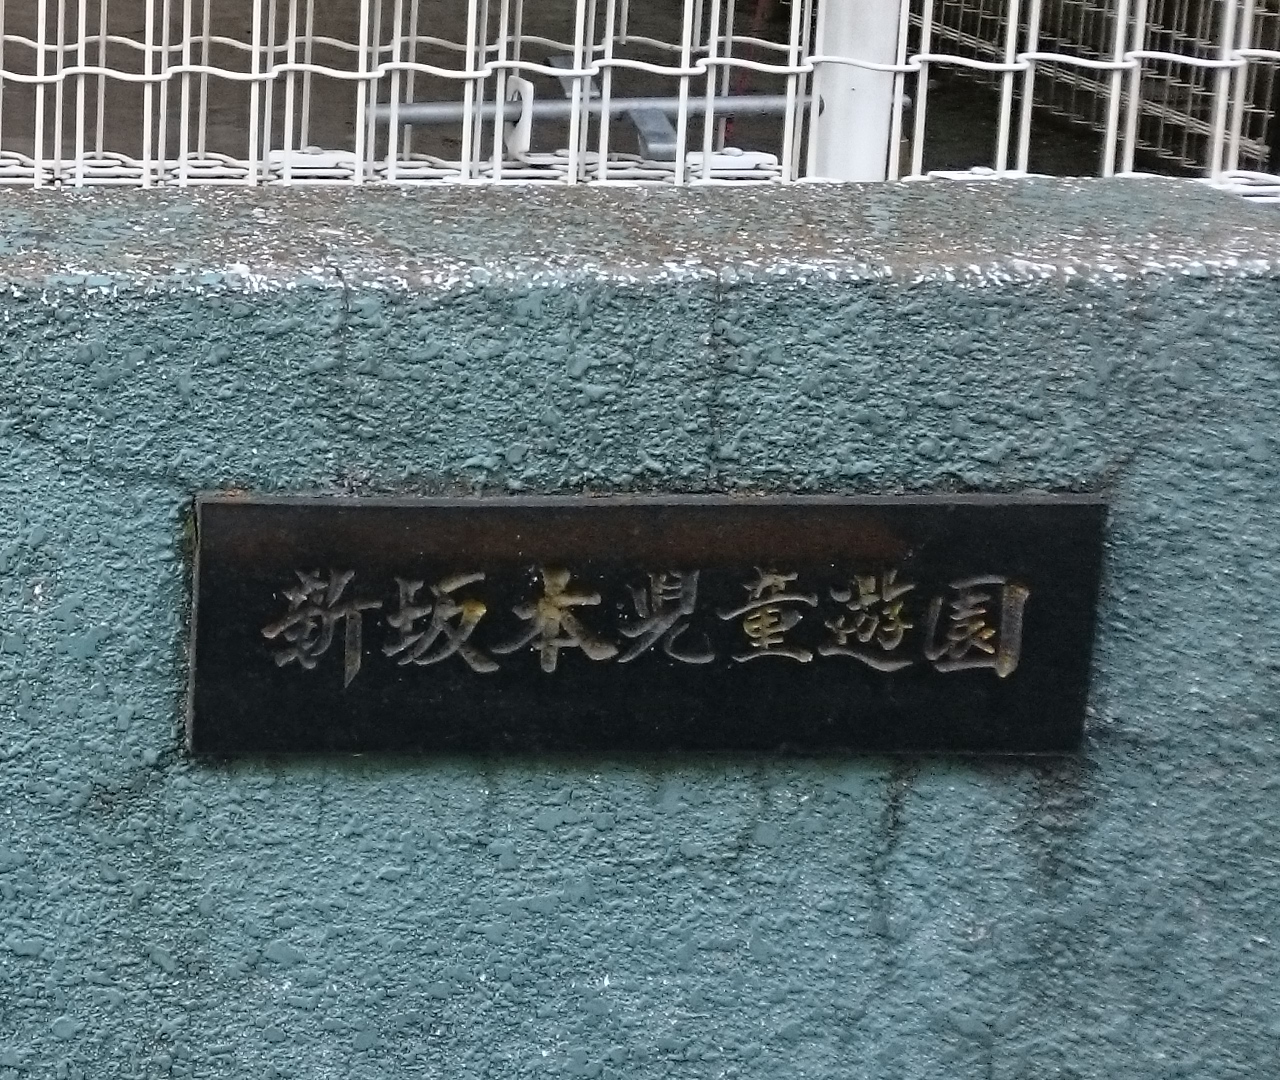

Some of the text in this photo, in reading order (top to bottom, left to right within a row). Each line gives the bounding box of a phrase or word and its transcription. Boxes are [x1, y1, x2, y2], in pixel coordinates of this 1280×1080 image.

[260, 568, 1032, 688] 新坂本児童遊園
